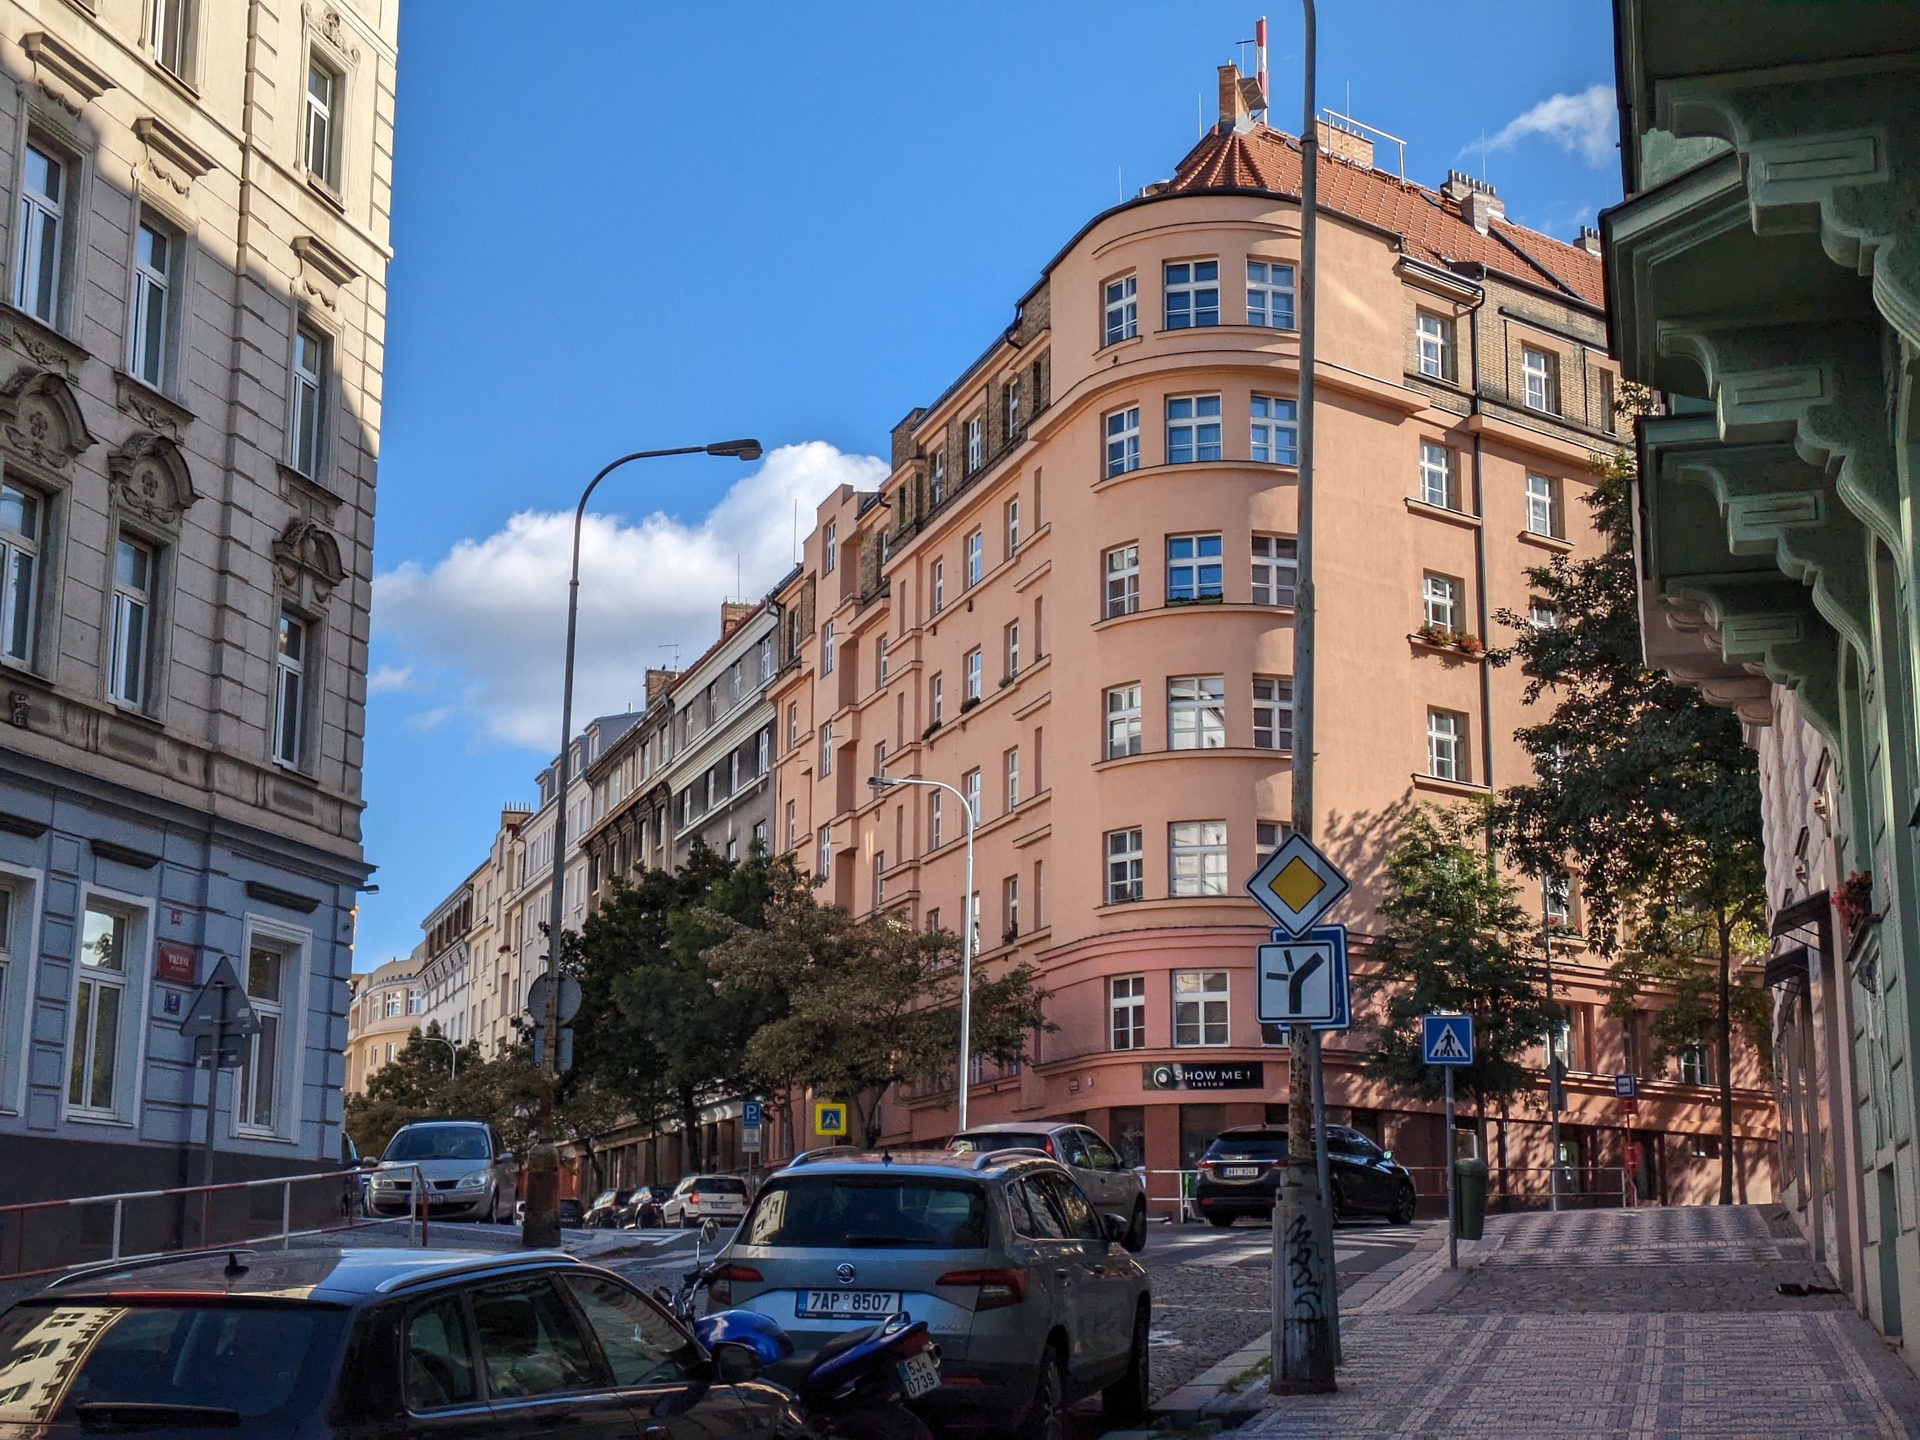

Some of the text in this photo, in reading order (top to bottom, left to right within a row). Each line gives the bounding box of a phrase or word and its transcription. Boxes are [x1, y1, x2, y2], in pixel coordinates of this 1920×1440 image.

[1175, 1070, 1216, 1081] SHOW
[811, 1292, 840, 1310] 7AP
[852, 1293, 892, 1312] 8507
[908, 1371, 935, 1394] 0739
